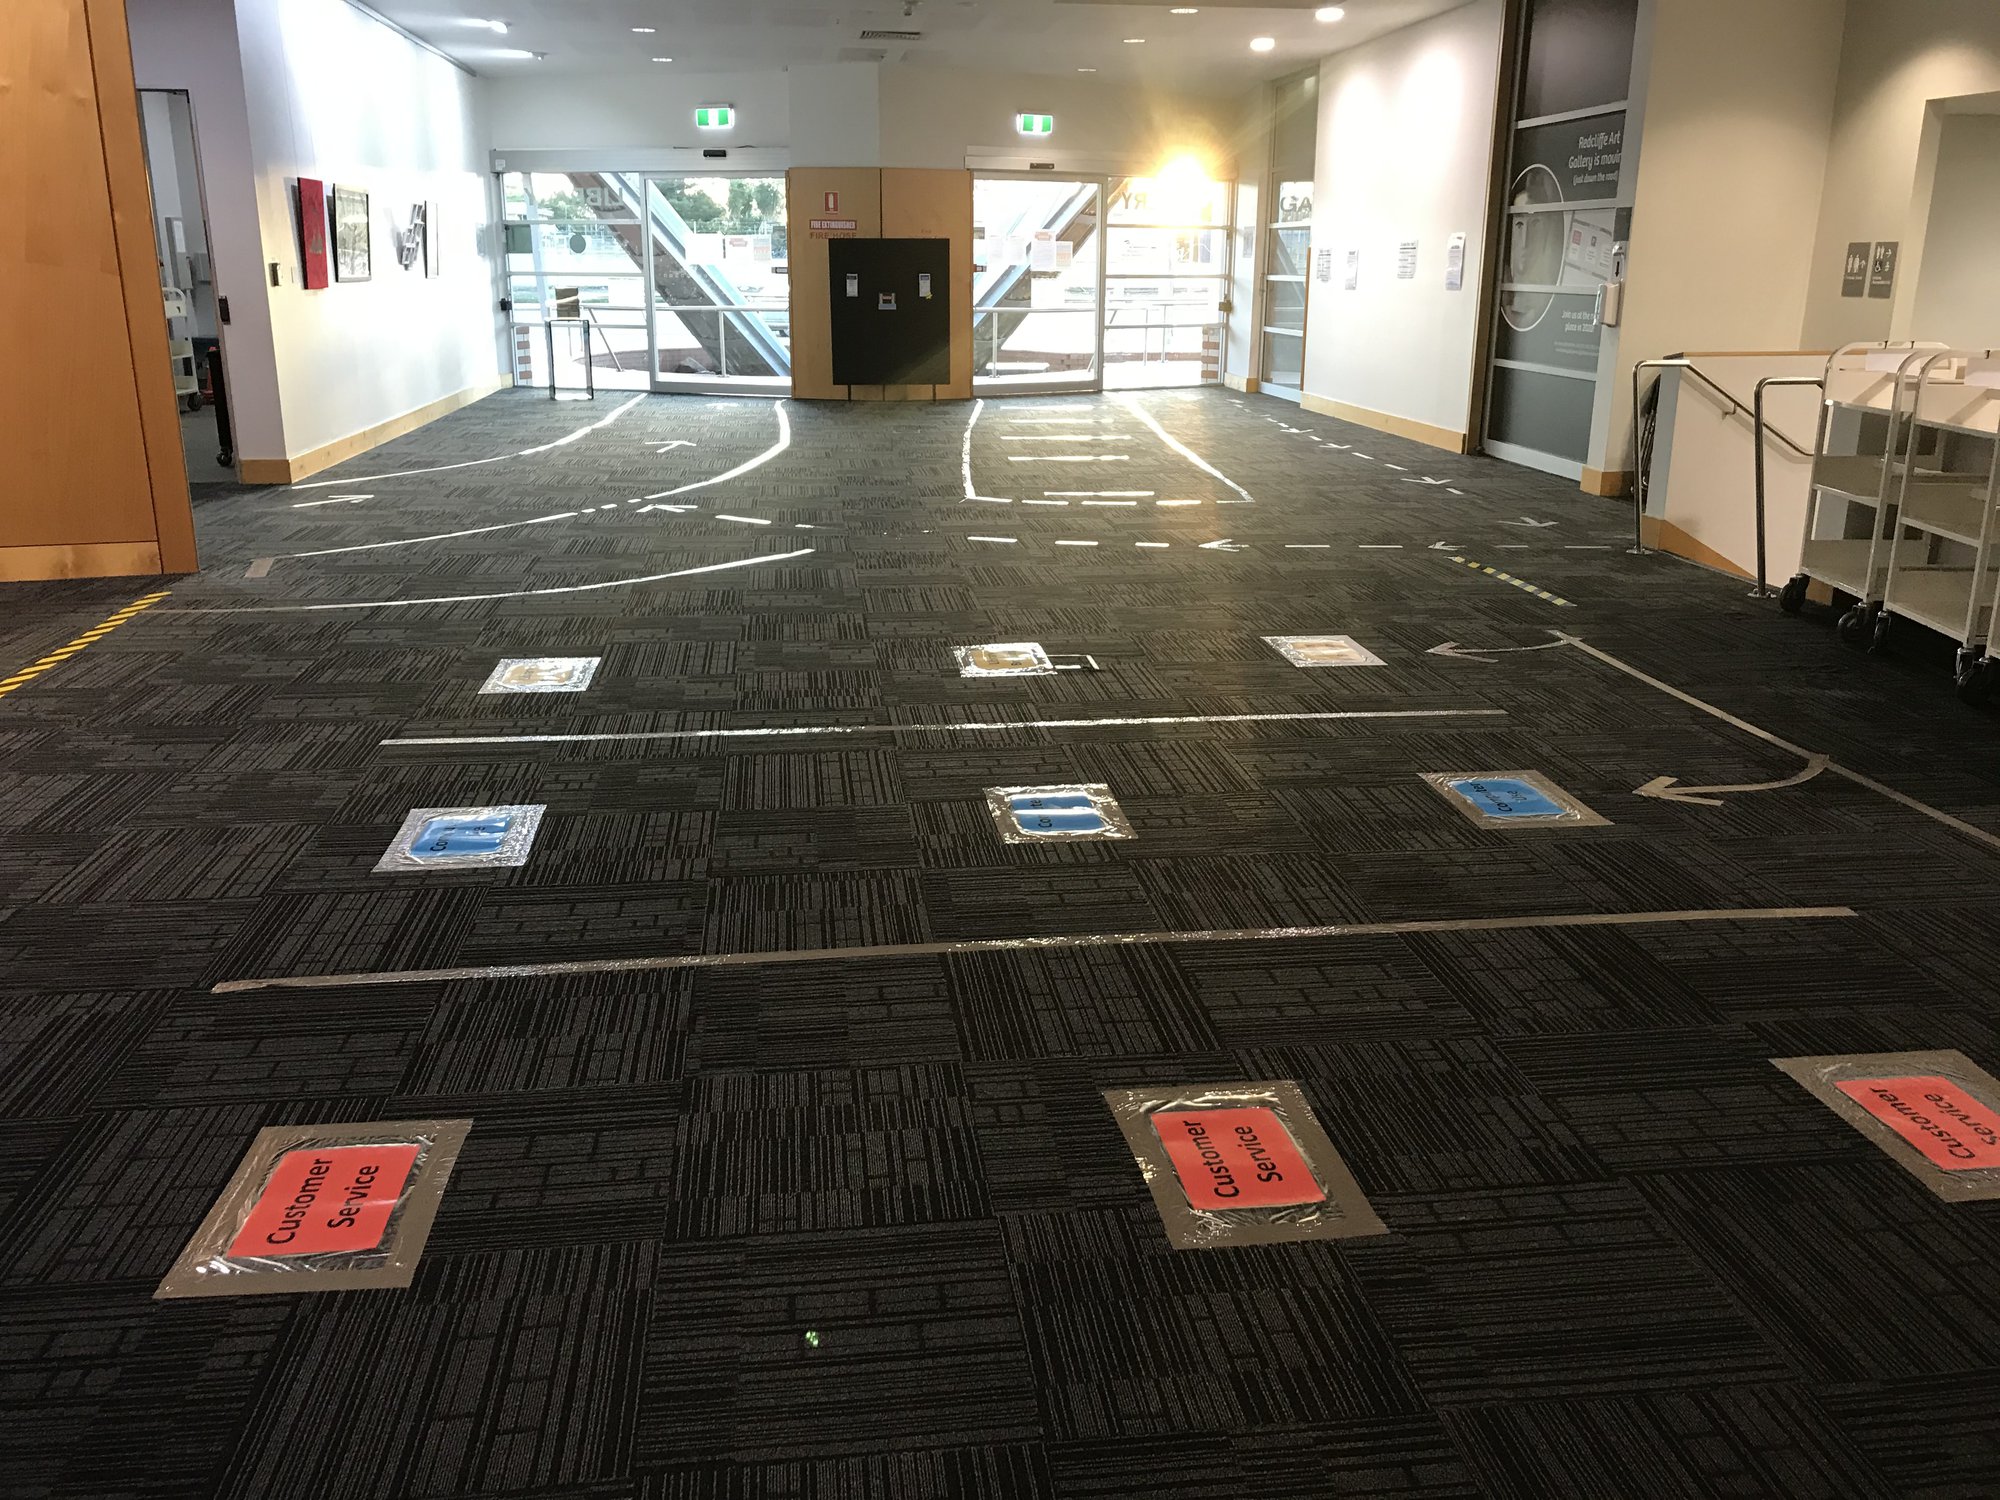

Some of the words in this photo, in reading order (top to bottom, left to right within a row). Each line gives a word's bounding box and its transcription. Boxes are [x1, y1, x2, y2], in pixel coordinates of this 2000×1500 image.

[1568, 153, 1593, 170] Gallery
[1594, 150, 1600, 166] is
[1578, 132, 1608, 150] Redcliffe
[1609, 131, 1621, 145] Art
[810, 231, 829, 239] FIRE
[1869, 1087, 1976, 1160] Customer
[1924, 1093, 1998, 1146] Service
[1183, 1120, 1240, 1198] Customer
[1234, 1126, 1283, 1183] Service
[266, 1157, 333, 1245] Customer
[327, 1165, 380, 1229] Service
